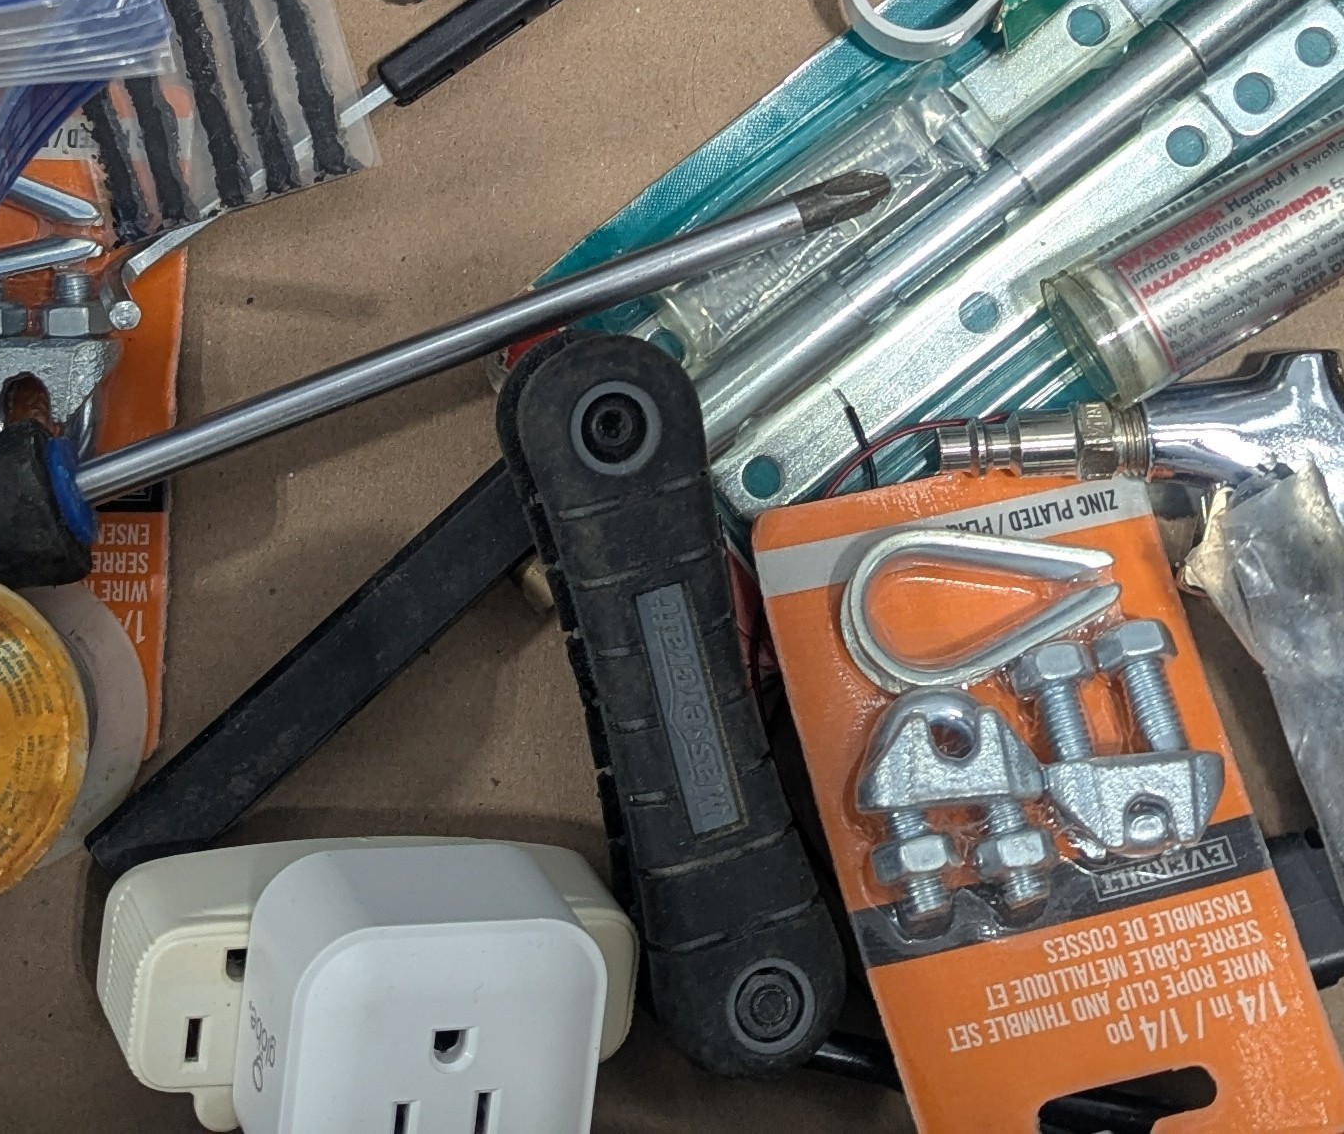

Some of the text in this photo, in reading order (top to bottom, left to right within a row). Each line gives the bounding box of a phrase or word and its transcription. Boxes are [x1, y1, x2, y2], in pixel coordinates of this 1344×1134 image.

[1224, 170, 1287, 213] Harmful
[1284, 161, 1301, 179] if
[1130, 247, 1181, 285] irritate
[1183, 215, 1244, 255] sensitive
[1246, 198, 1280, 219] skin.
[1137, 237, 1233, 302] HAZARDOUS
[1234, 276, 1264, 300] with
[1294, 245, 1318, 266] and
[1008, 498, 1074, 532] PLATED
[1076, 488, 1119, 517] ZINC
[99, 578, 148, 603] WIRE
[1096, 841, 1231, 895] EVERBILT
[1042, 889, 1253, 964] ENSEMBLE DE COSSES
[985, 919, 1264, 1011] SERRE-CÂBLE MÉTALLIQUE ET
[947, 948, 1275, 1053] WIRE ROPE CLIP AND THIMBLE SET
[1209, 993, 1233, 1019] in
[1236, 980, 1288, 1025] 1/4
[1105, 1013, 1135, 1045] po
[1138, 1007, 1189, 1052] 1/4
